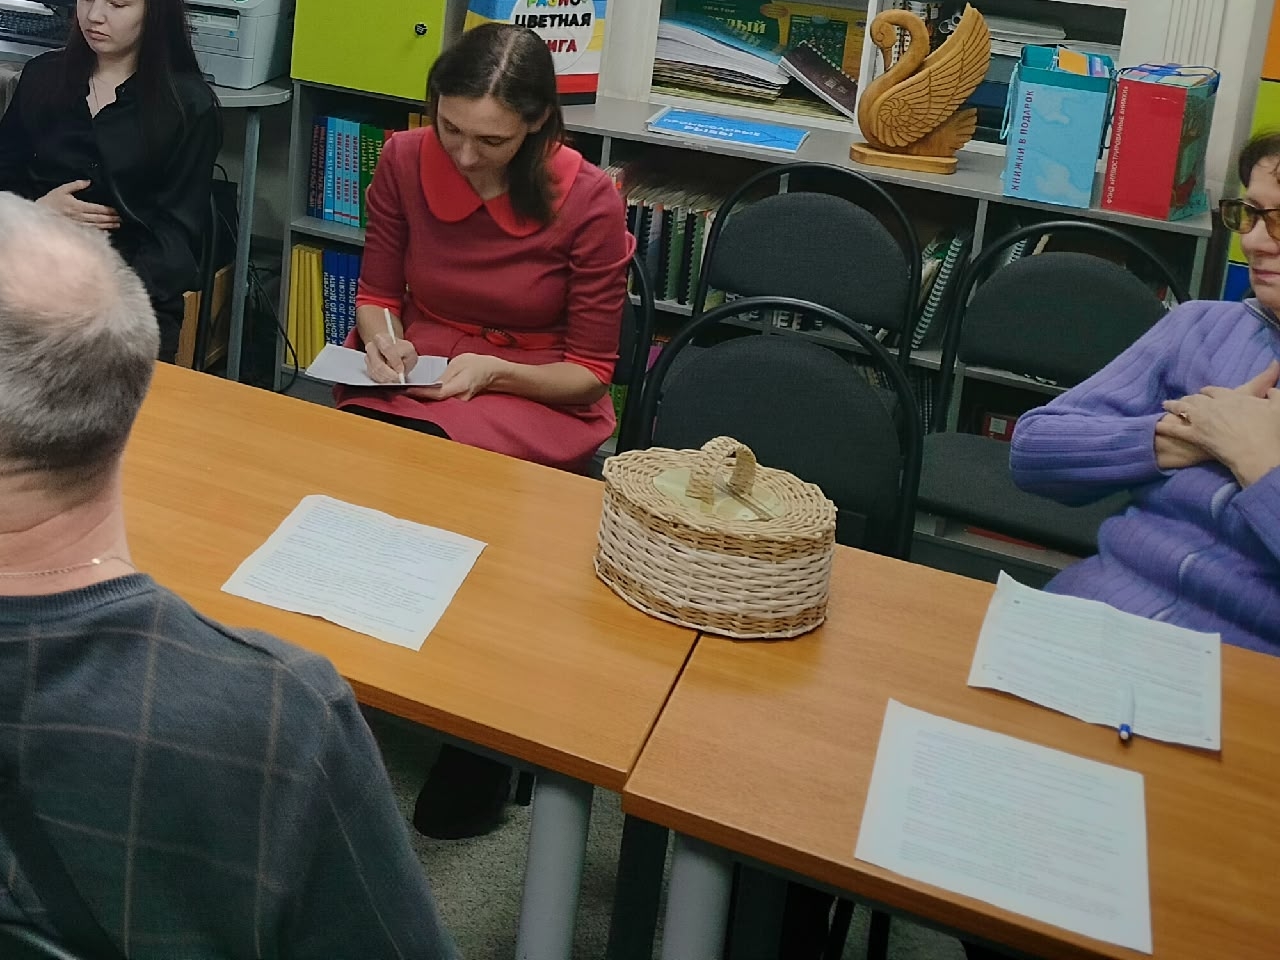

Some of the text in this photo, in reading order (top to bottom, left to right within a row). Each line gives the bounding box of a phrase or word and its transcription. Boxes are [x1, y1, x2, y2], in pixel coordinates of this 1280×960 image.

[514, 12, 592, 29] ЦВЕТНАЯ
[545, 38, 578, 53] ИГА
[1011, 148, 1026, 191] КНИЖКИ
[1020, 90, 1035, 135] ПОДАРОК
[1106, 185, 1116, 204] ФОНД
